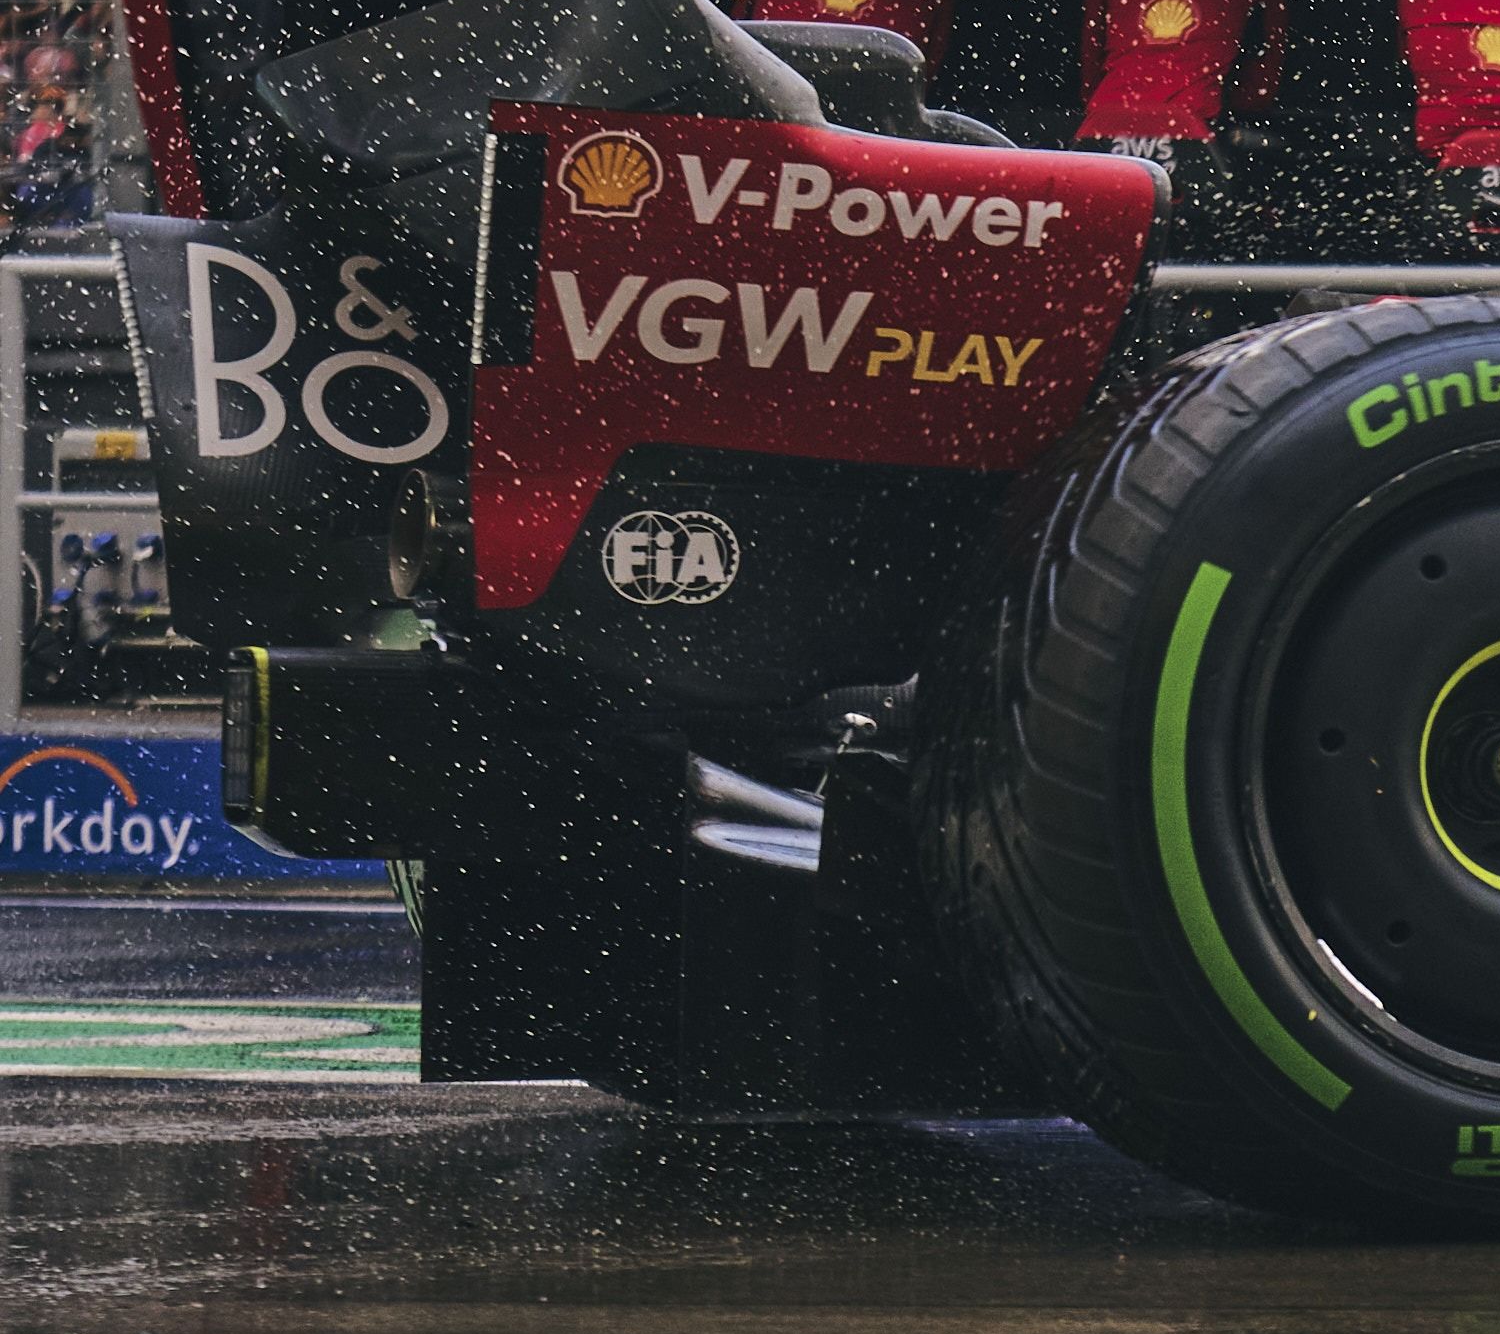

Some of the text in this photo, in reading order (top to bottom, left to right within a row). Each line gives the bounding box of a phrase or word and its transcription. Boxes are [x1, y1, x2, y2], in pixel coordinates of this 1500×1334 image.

[676, 153, 1063, 249] V-Power
[550, 270, 1044, 387] VGW PLAY
[0, 797, 194, 868] rkday
